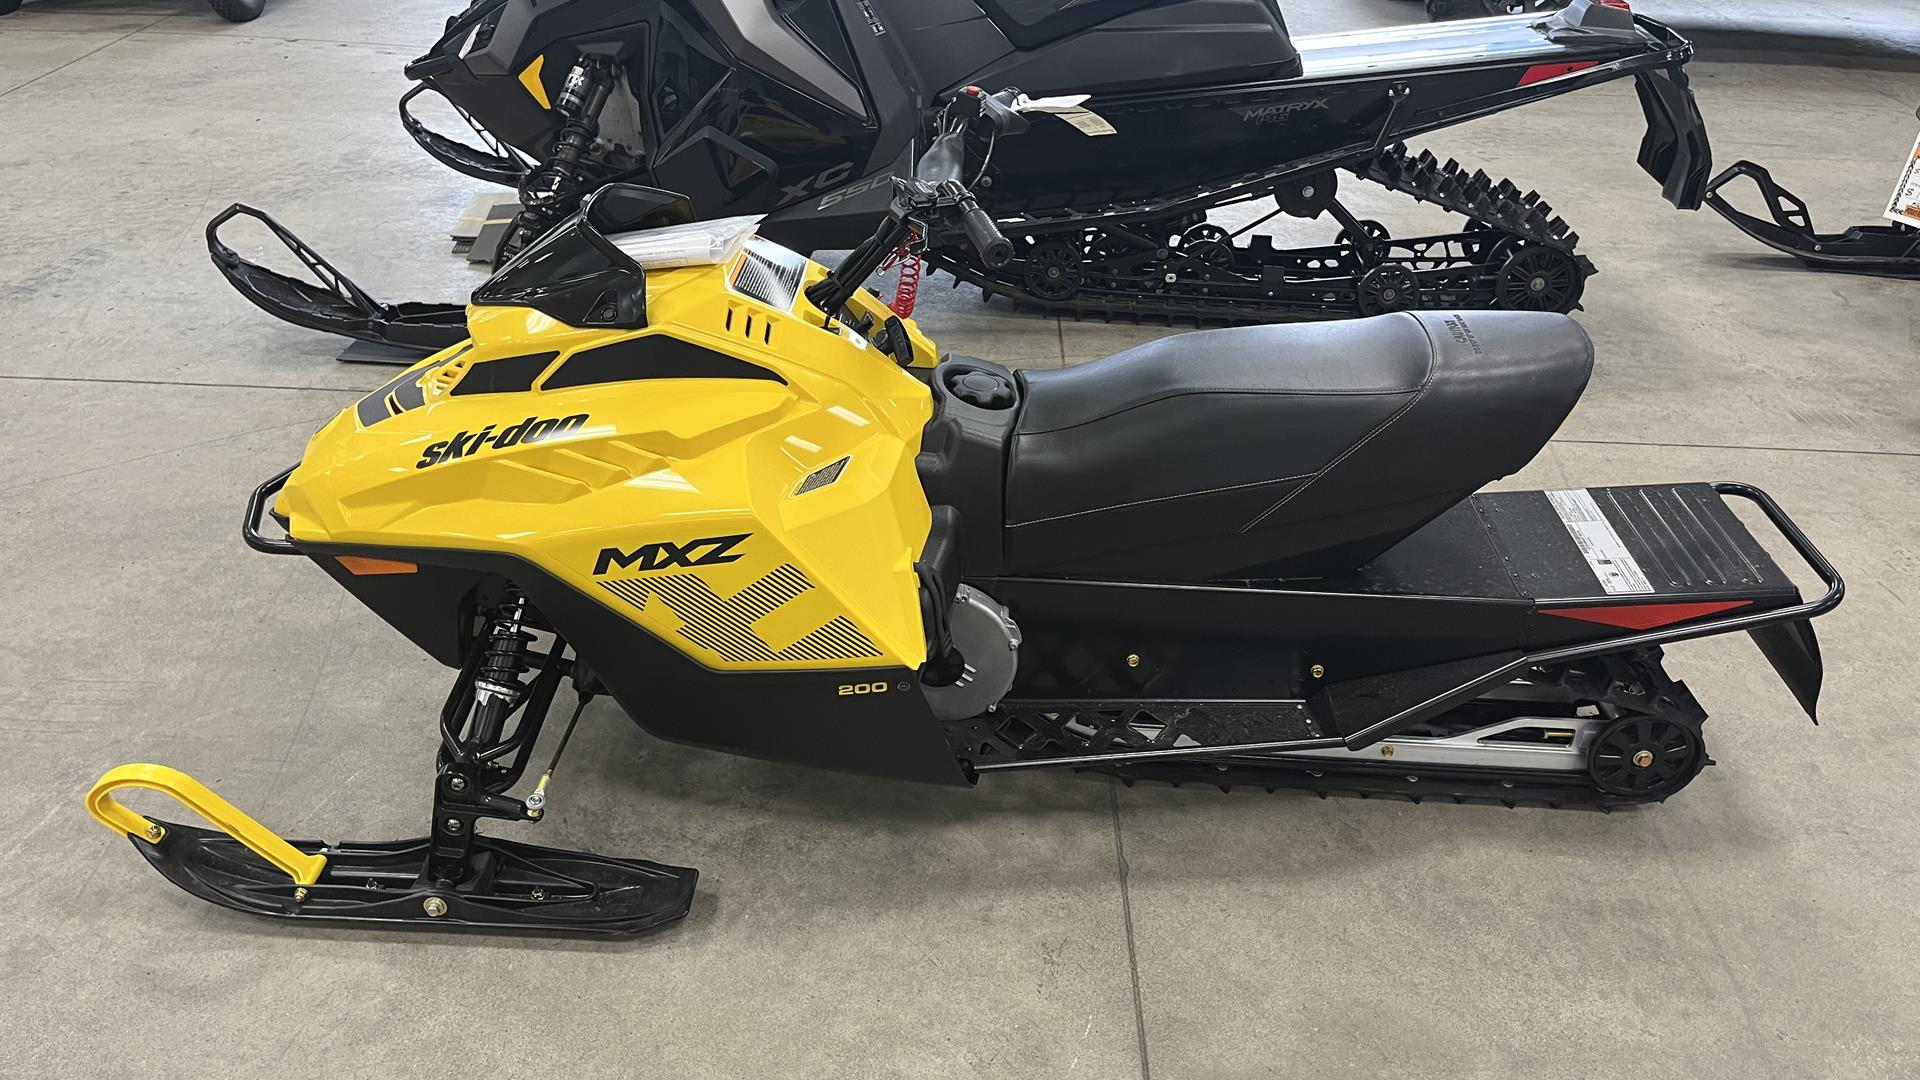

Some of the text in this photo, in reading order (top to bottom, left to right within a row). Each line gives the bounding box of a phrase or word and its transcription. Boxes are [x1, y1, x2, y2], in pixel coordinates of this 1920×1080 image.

[1243, 98, 1329, 121] MATRYX
[775, 161, 854, 207] XC
[416, 413, 590, 469] ski-doo
[592, 533, 754, 575] MXZ
[838, 682, 888, 696] 200
